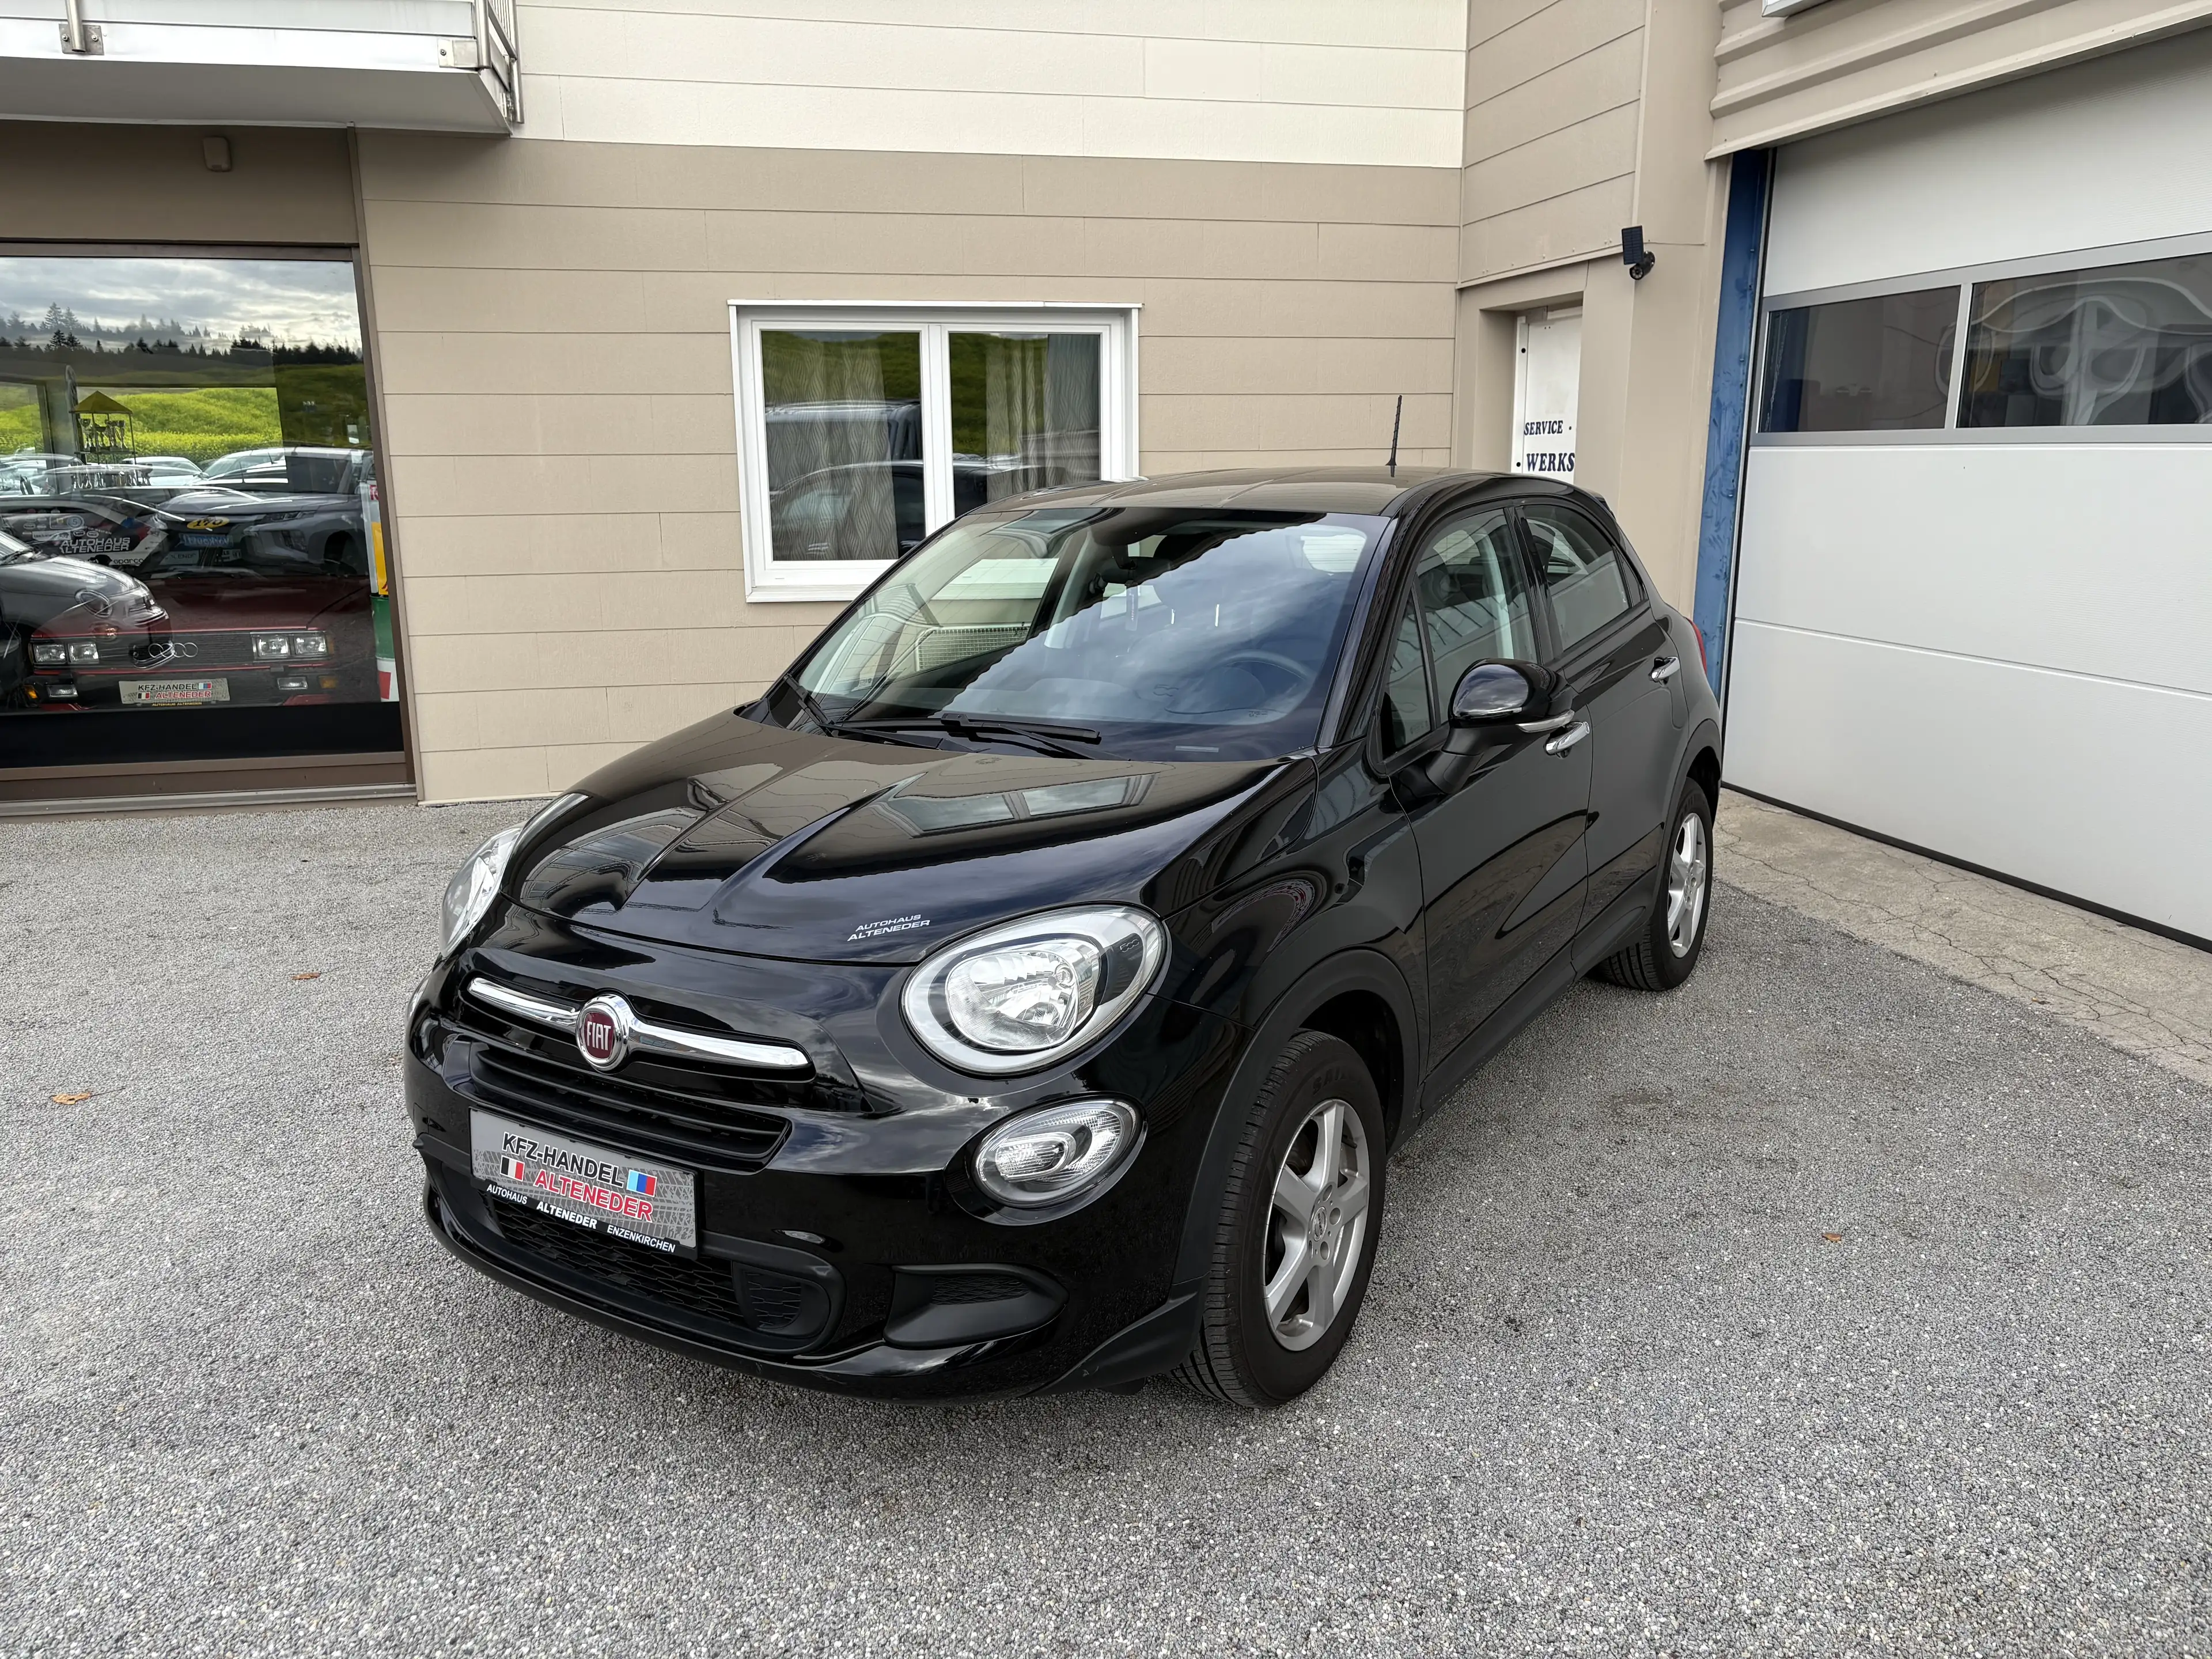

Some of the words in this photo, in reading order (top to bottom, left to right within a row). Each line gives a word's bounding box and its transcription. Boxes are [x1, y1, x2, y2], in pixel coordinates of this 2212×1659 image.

[1524, 420, 1563, 435] SERVICE
[1527, 452, 1575, 472] WERKS
[60, 537, 130, 548] AUTOHAUS
[138, 683, 197, 691] KFZ-HANDEL
[155, 691, 211, 699] ALTENEDER
[847, 919, 930, 942] ALTENEDER
[855, 914, 922, 932] AUTOHAUS
[586, 1021, 612, 1051] FIAT
[502, 1132, 624, 1188] KFZ-HANDEL
[533, 1169, 653, 1223] ALTENEDER
[487, 1184, 528, 1205] AUTOHAUS
[536, 1201, 598, 1229] ALTENEDER
[607, 1224, 676, 1253] ENZENKIRCHEN
